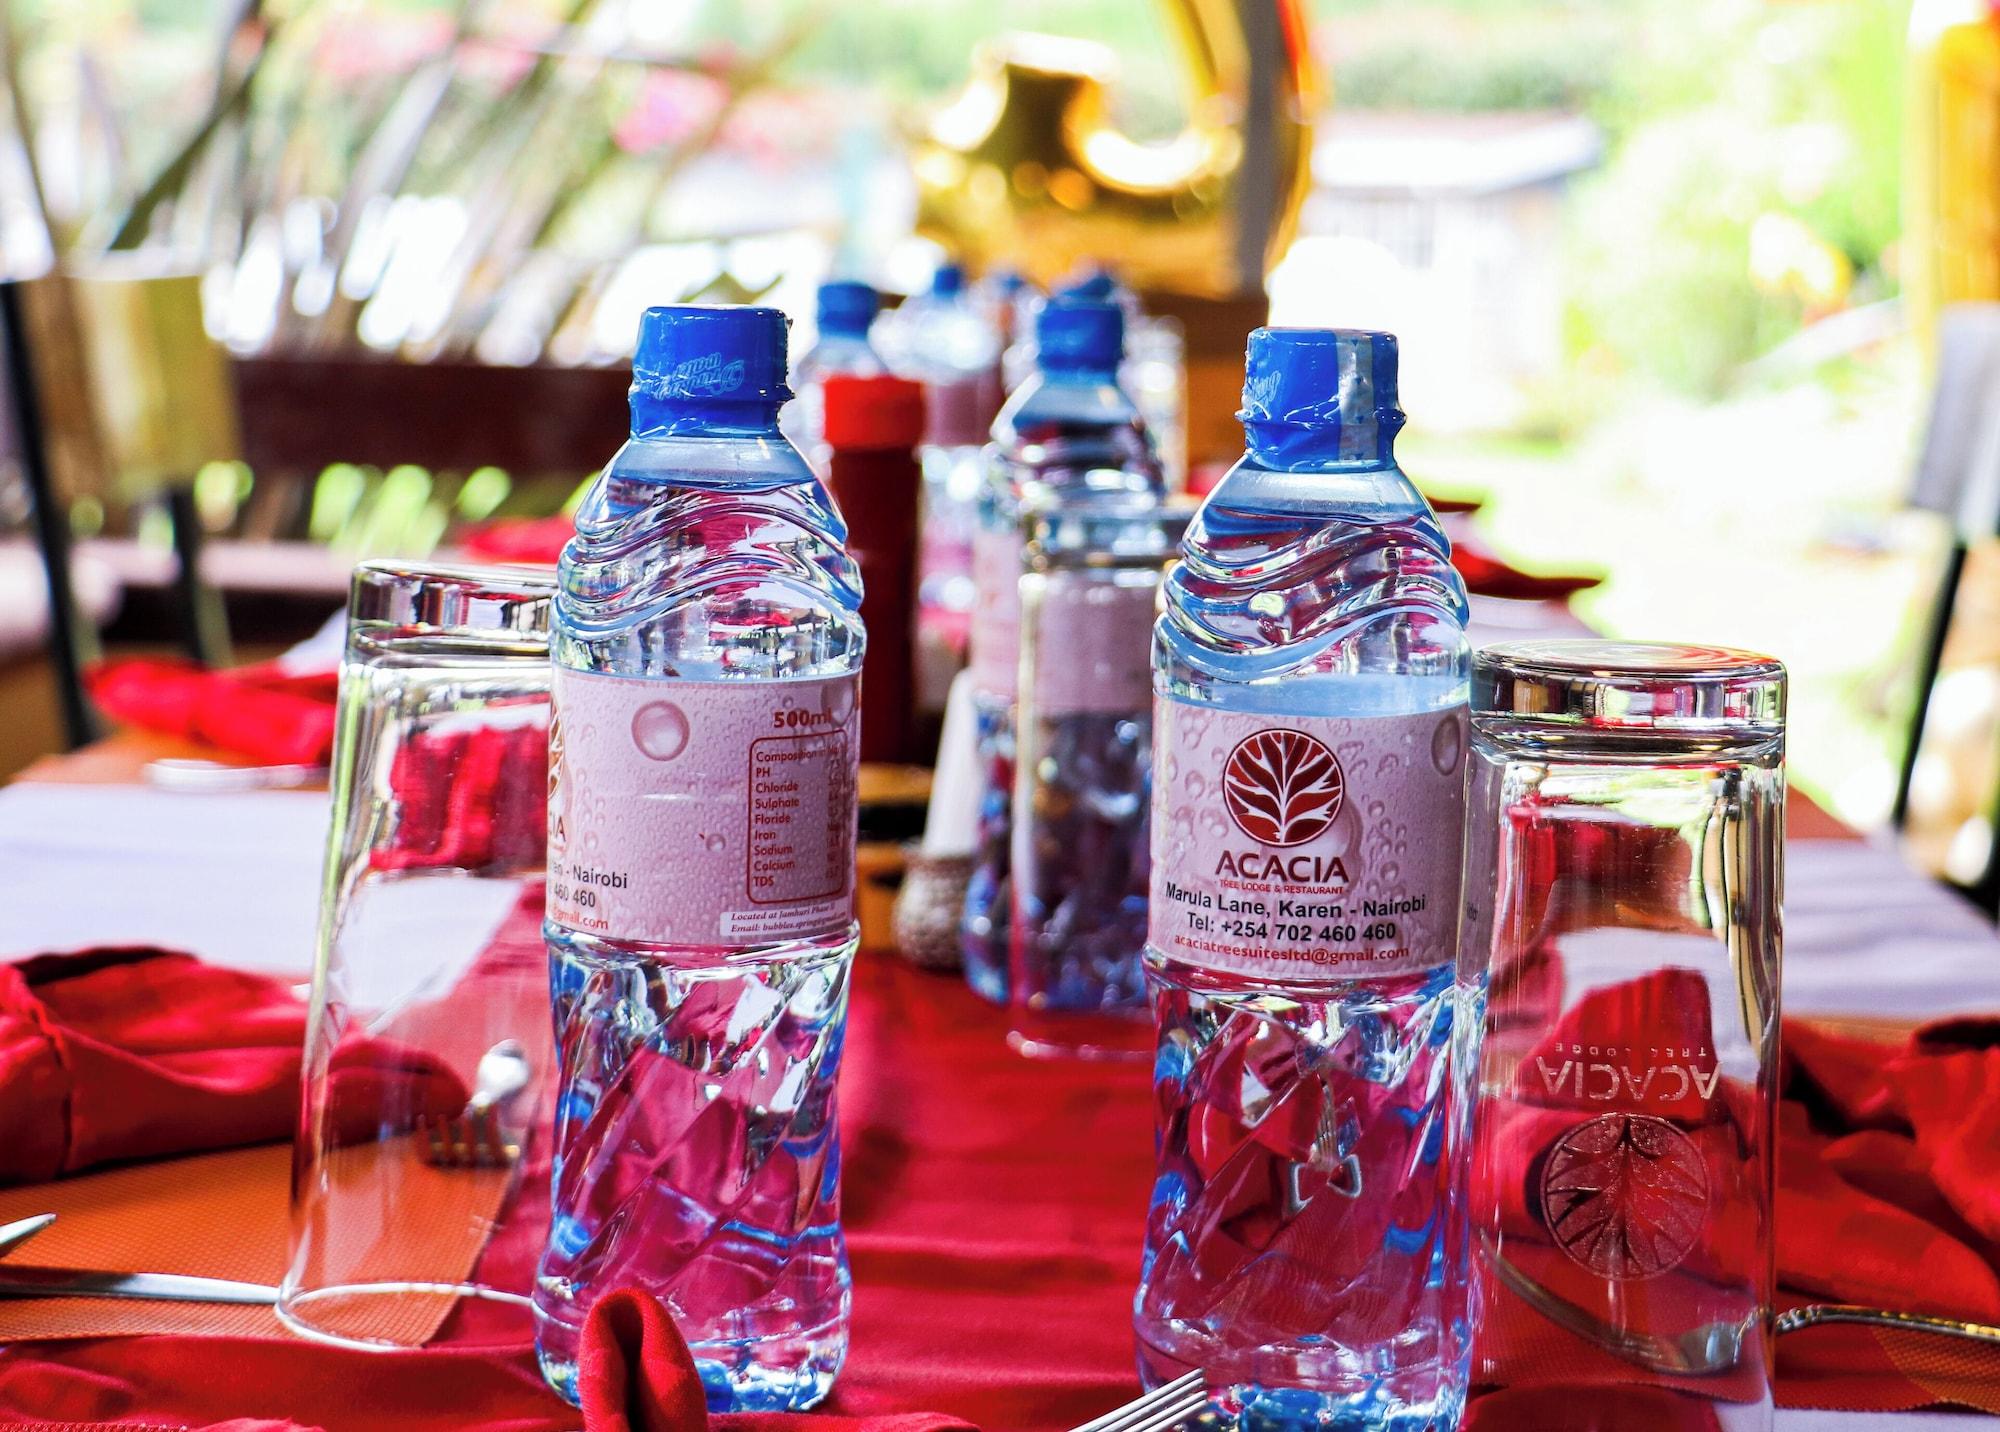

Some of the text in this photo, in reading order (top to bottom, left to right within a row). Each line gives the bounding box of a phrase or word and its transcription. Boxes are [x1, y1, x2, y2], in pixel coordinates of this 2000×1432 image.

[774, 707, 832, 728] 500ml
[756, 748, 817, 763] Composition
[756, 767, 770, 778] PH
[755, 781, 799, 793] Chloride
[755, 797, 799, 810] Sulphate
[755, 814, 791, 825] Floride
[755, 830, 776, 840] Iron
[754, 845, 793, 856] Sodium
[754, 860, 795, 872] Calcium
[1215, 850, 1349, 883] ACACIA
[573, 864, 627, 889] Nairobi
[753, 876, 774, 887] TDS
[1220, 880, 1344, 895] TREE LODGE & RESTAURANT
[573, 888, 596, 908] 460
[1166, 881, 1212, 908] Marula
[1218, 894, 1271, 919] Lane,
[1279, 900, 1342, 918] Karen
[1363, 894, 1426, 917] Nairobi
[731, 912, 766, 921] Located
[768, 911, 777, 919] at
[779, 907, 811, 920] Jamhuri
[731, 922, 760, 933] Email:
[1187, 911, 1397, 942] Tel: +254 702 460 460
[1174, 934, 1410, 965] acaciatreesuitesltd@gmail.com
[1535, 1055, 1721, 1101] ACACIA
